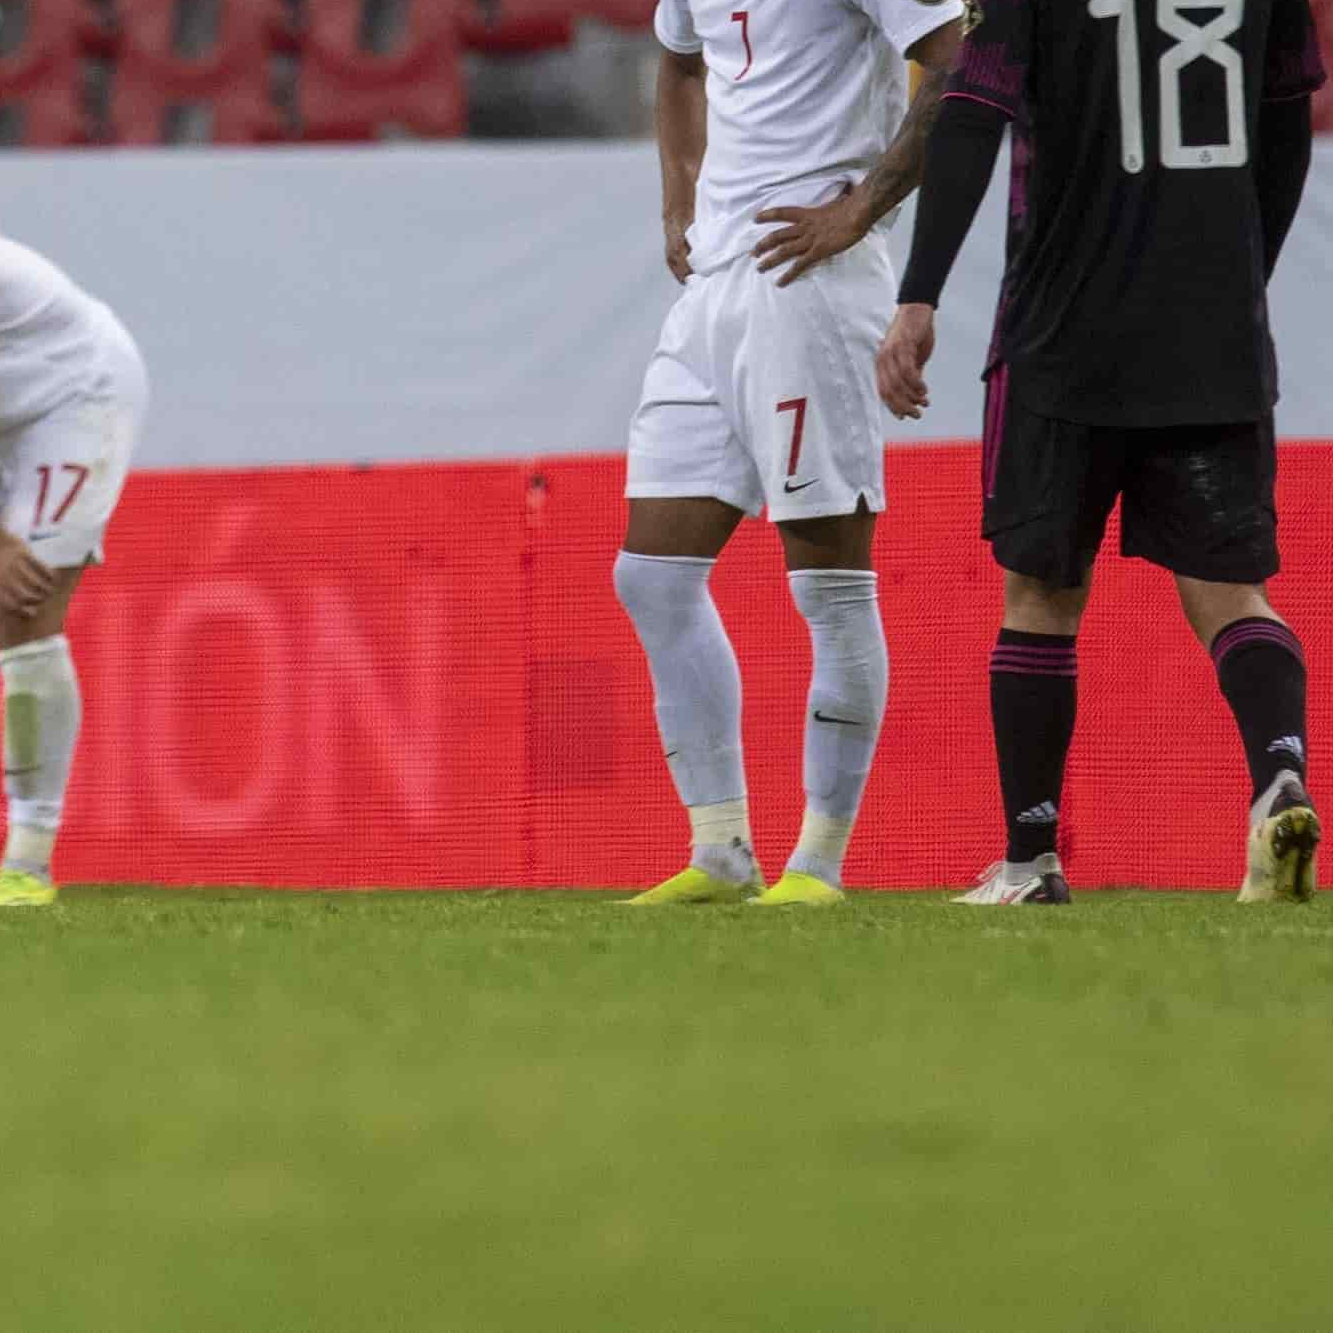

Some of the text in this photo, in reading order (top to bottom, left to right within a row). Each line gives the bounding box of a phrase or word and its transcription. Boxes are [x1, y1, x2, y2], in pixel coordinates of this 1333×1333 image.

[730, 10, 753, 81] 7
[775, 396, 808, 477] 7
[33, 463, 90, 526] 17
